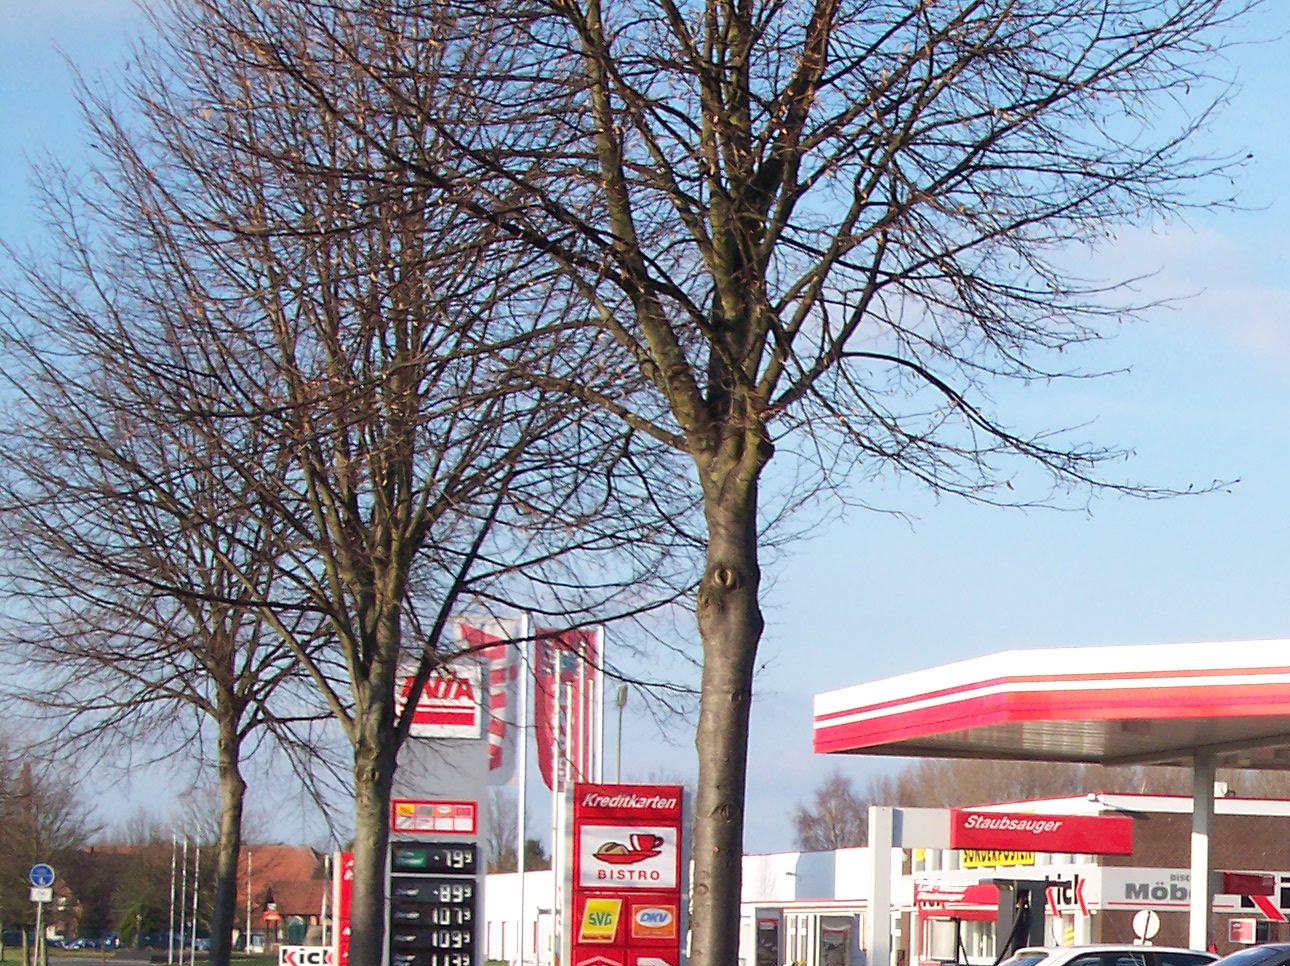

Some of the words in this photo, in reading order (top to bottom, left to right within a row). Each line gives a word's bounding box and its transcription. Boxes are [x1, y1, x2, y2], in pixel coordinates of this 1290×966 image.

[581, 793, 677, 809] Kreditkarten
[964, 815, 1062, 833] Staubsauger
[597, 869, 660, 881] BISTRO
[1125, 882, 1190, 901] Möb
[588, 911, 612, 926] SVG
[640, 912, 668, 923] DKV
